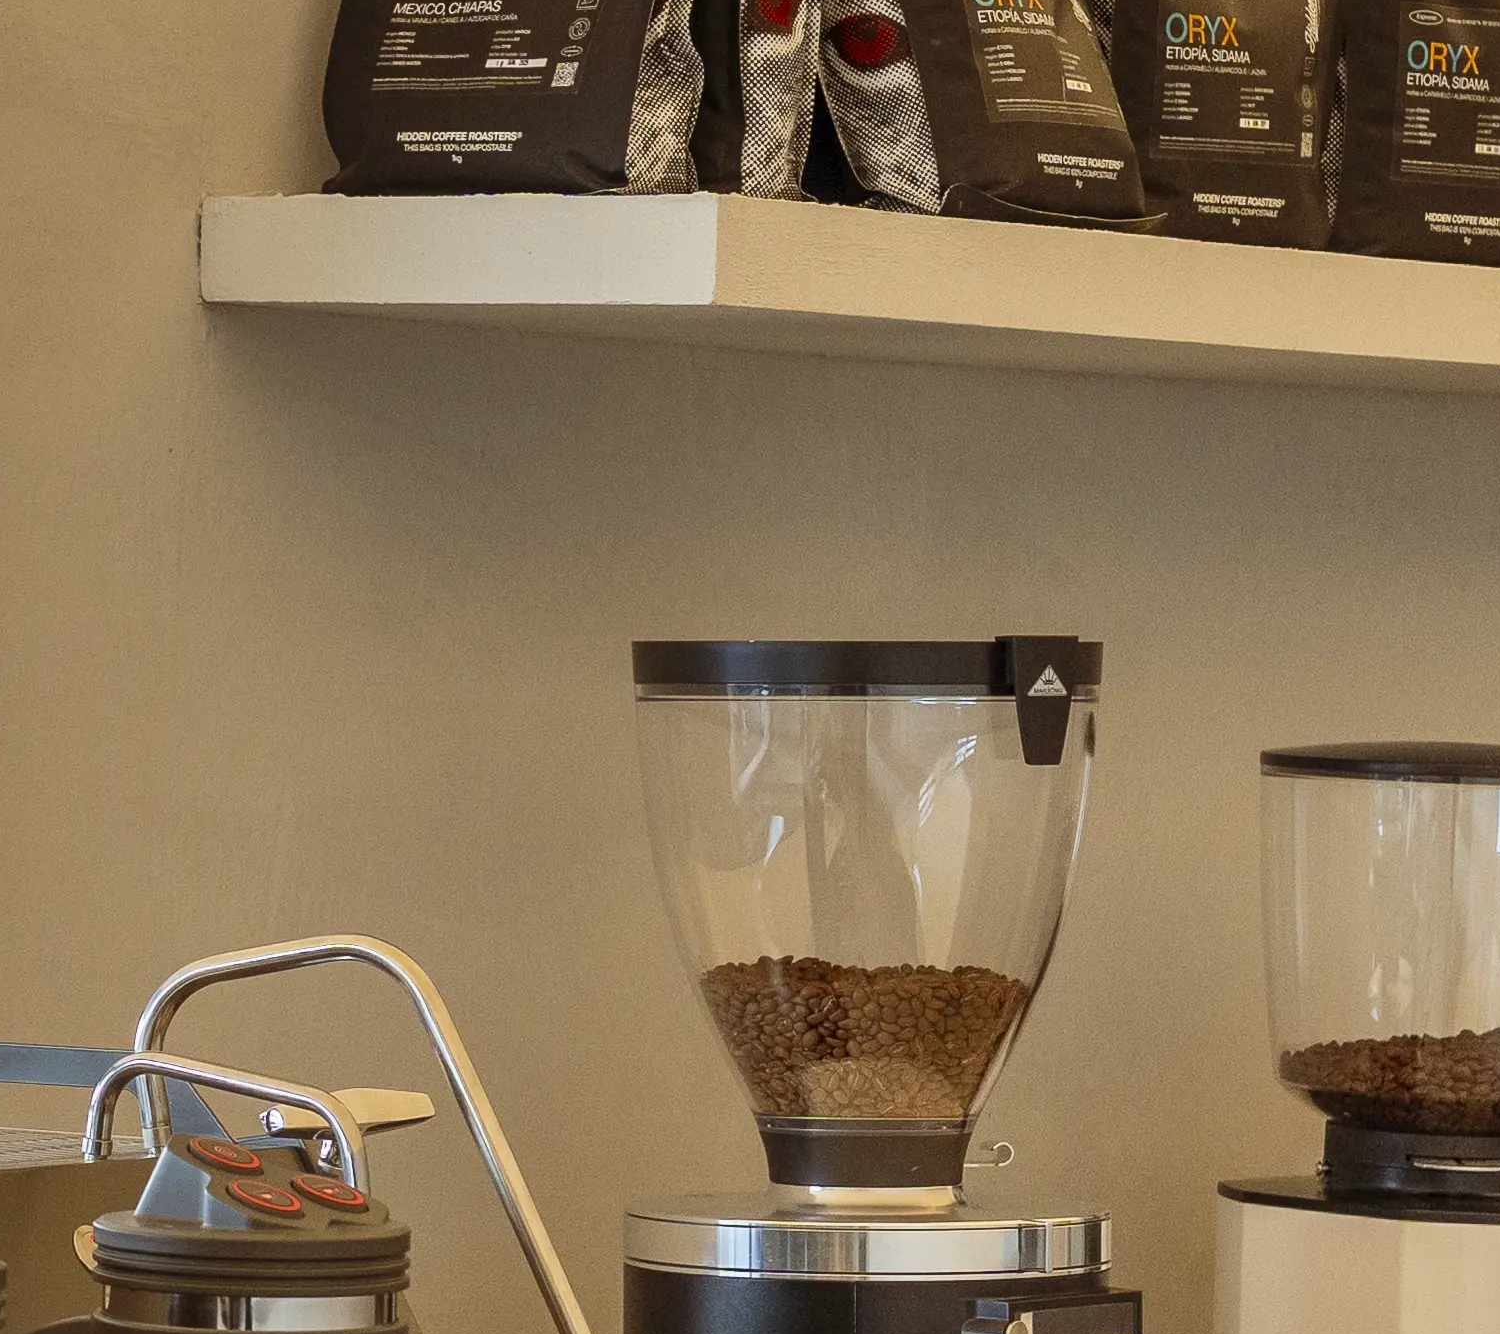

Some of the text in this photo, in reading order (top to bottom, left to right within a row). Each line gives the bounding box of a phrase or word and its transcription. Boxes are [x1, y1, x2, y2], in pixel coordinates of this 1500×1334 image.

[447, 0, 502, 15] CHIAPAS
[1165, 12, 1239, 47] ORYX
[1211, 49, 1251, 64] SIDAMA
[1407, 40, 1479, 75] ORYX
[1451, 75, 1489, 91] SIDAMA
[396, 131, 431, 141] HIDDEN
[432, 131, 468, 141] COFFEE
[404, 144, 419, 152] THIS
[419, 144, 434, 152] BAG
[442, 144, 460, 152] 100%
[460, 143, 513, 152] COMPOSTABLE
[1037, 153, 1063, 164] HIDDEN
[1063, 155, 1087, 167] COFFEE
[1193, 193, 1221, 204] HIDDEN
[1221, 195, 1247, 205] COFFEE
[1425, 212, 1452, 223] HIDDEN
[1452, 214, 1479, 225] COFFEE
